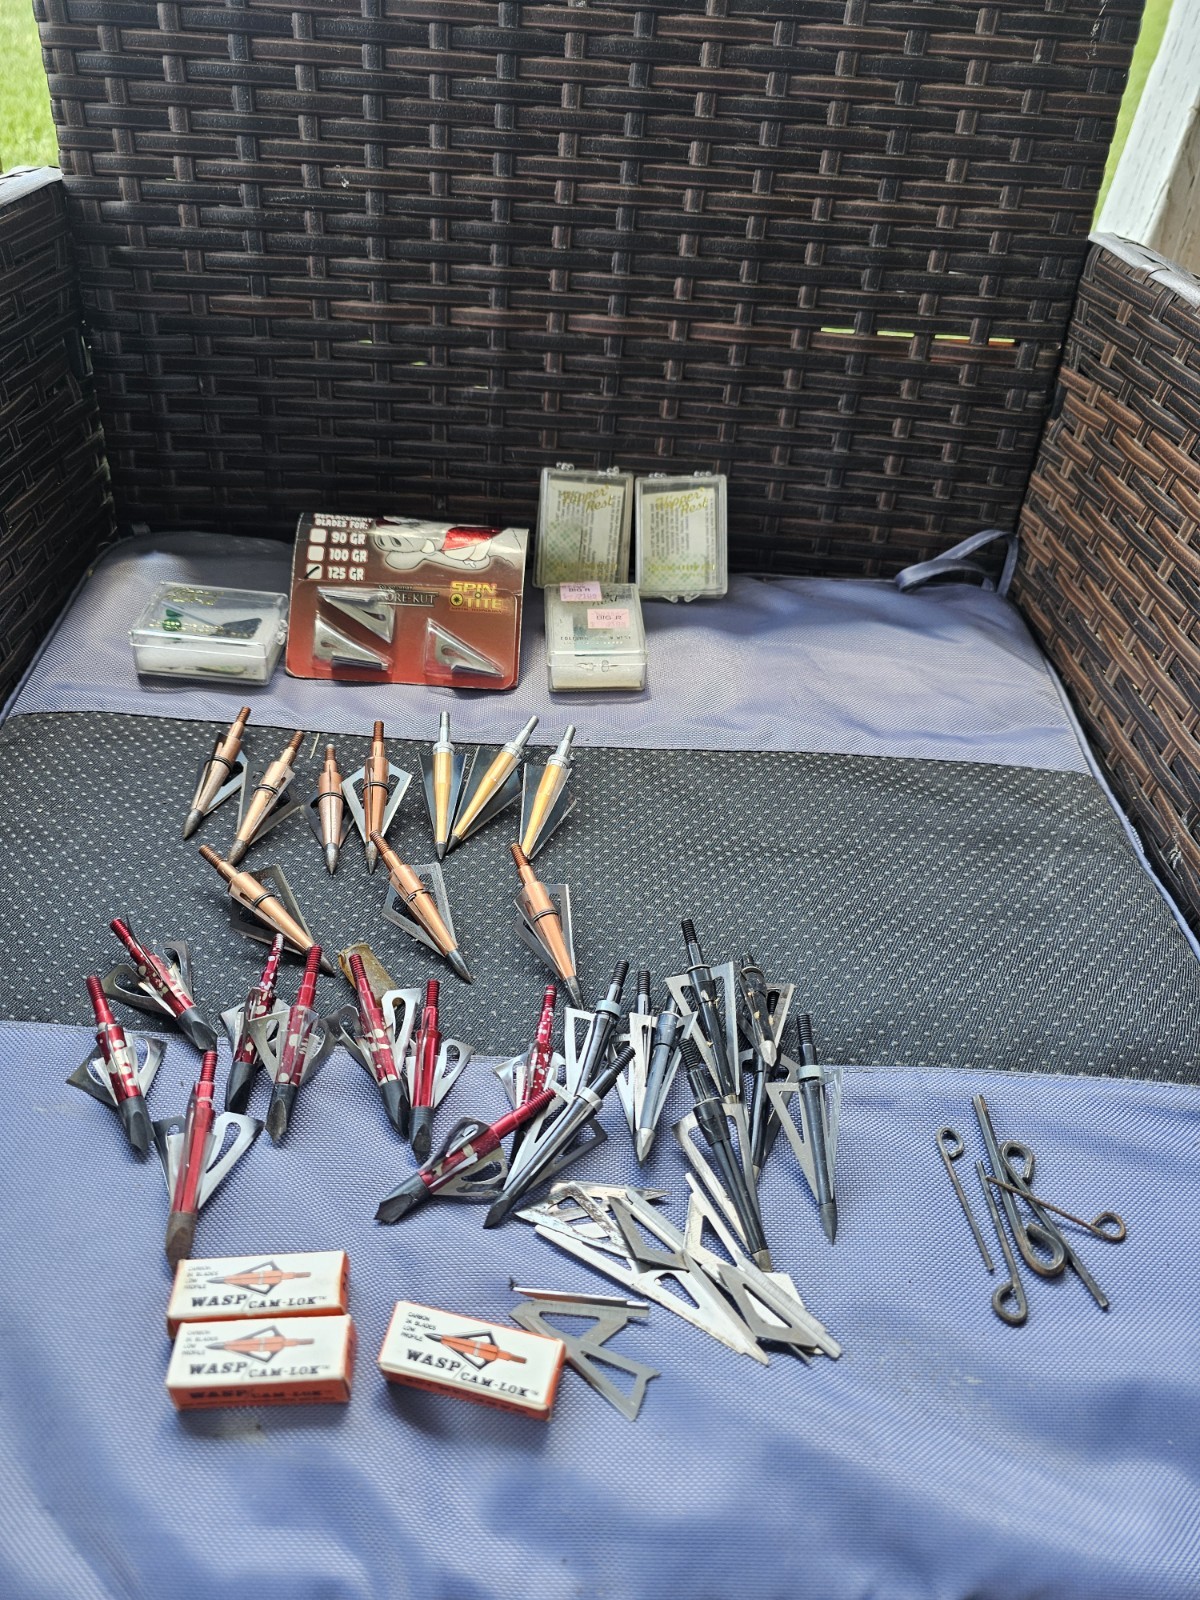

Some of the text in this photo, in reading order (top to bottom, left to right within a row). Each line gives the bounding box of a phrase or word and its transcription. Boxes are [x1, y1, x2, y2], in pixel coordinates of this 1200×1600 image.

[331, 531, 366, 545] 90 GR
[329, 548, 367, 563] 100 GR
[328, 566, 364, 581] 125 GR
[452, 581, 497, 594] SPIN
[466, 595, 502, 609] TITE
[192, 1293, 248, 1308] WASP
[407, 1348, 461, 1372] WASP
[190, 1361, 248, 1375] WASP
